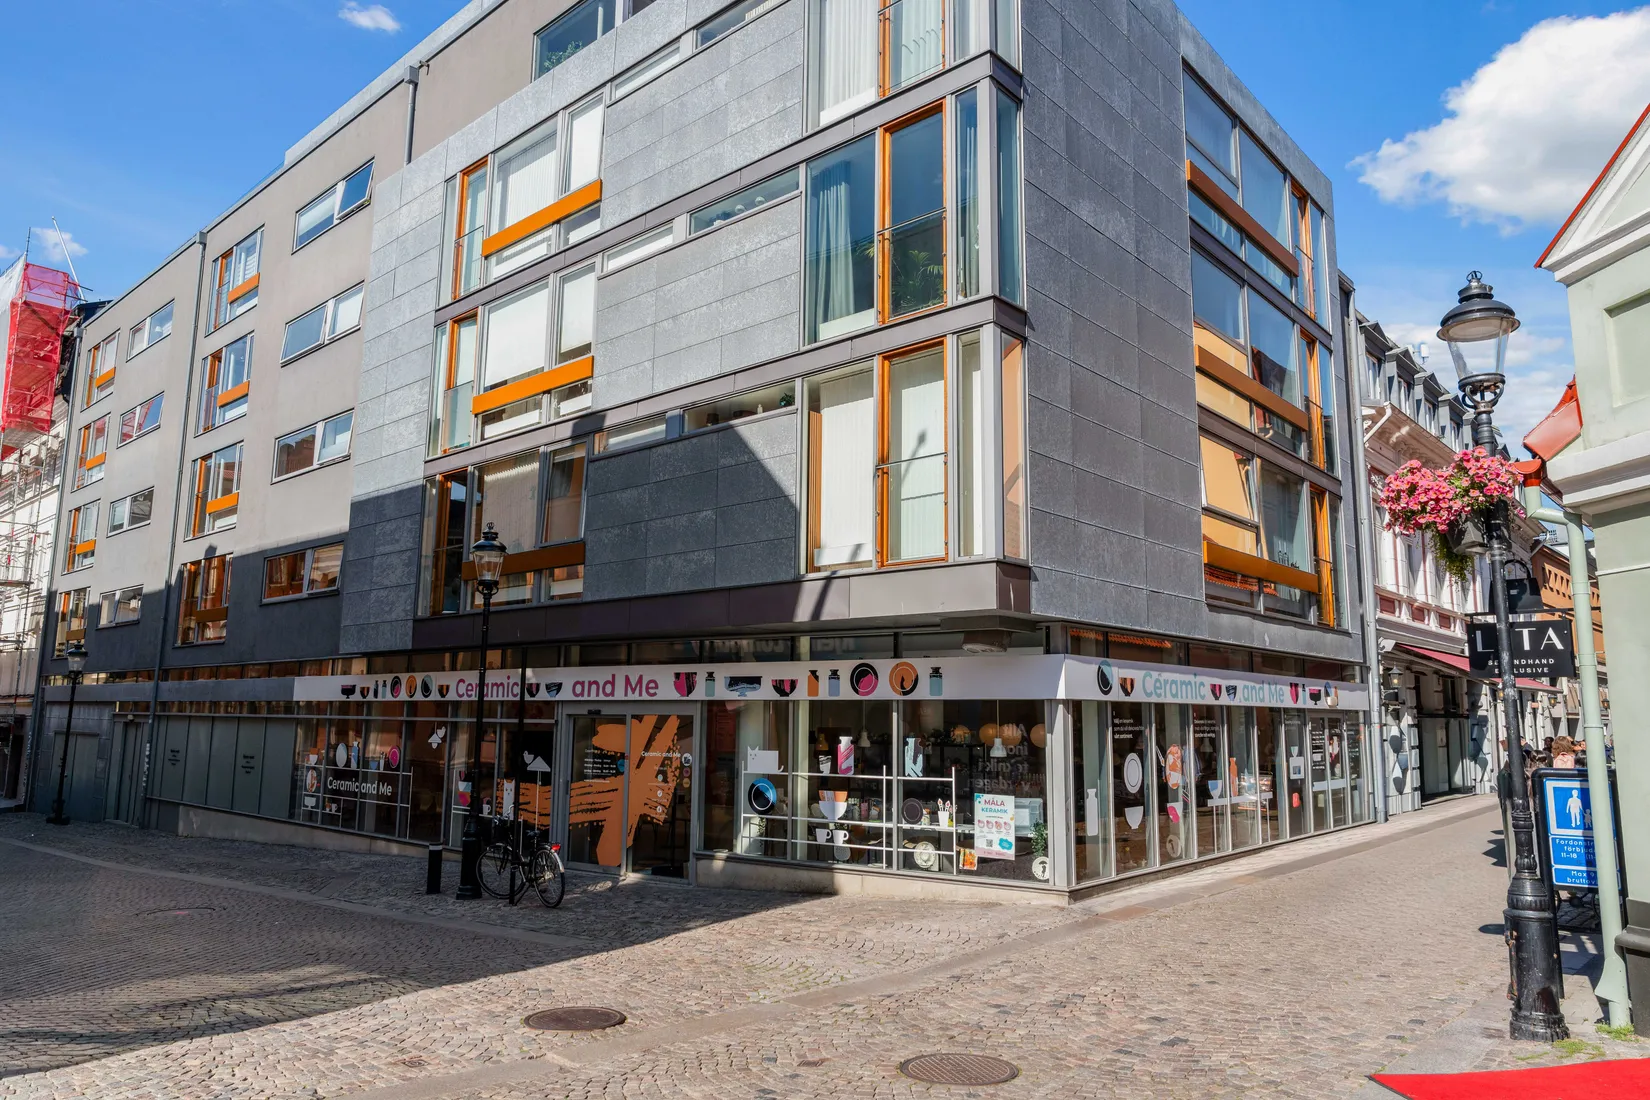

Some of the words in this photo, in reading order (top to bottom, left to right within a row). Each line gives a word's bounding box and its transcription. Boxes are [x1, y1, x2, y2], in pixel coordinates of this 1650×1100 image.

[1475, 627, 1564, 652] LTA
[1488, 658, 1555, 666] SENDHAND
[572, 673, 616, 698] and
[624, 674, 659, 698] Me
[1242, 680, 1265, 703] and
[1267, 681, 1284, 704] Me
[327, 776, 359, 792] Ceramic
[361, 780, 377, 794] and
[379, 781, 392, 796] Me
[984, 798, 1006, 807] MÅLA
